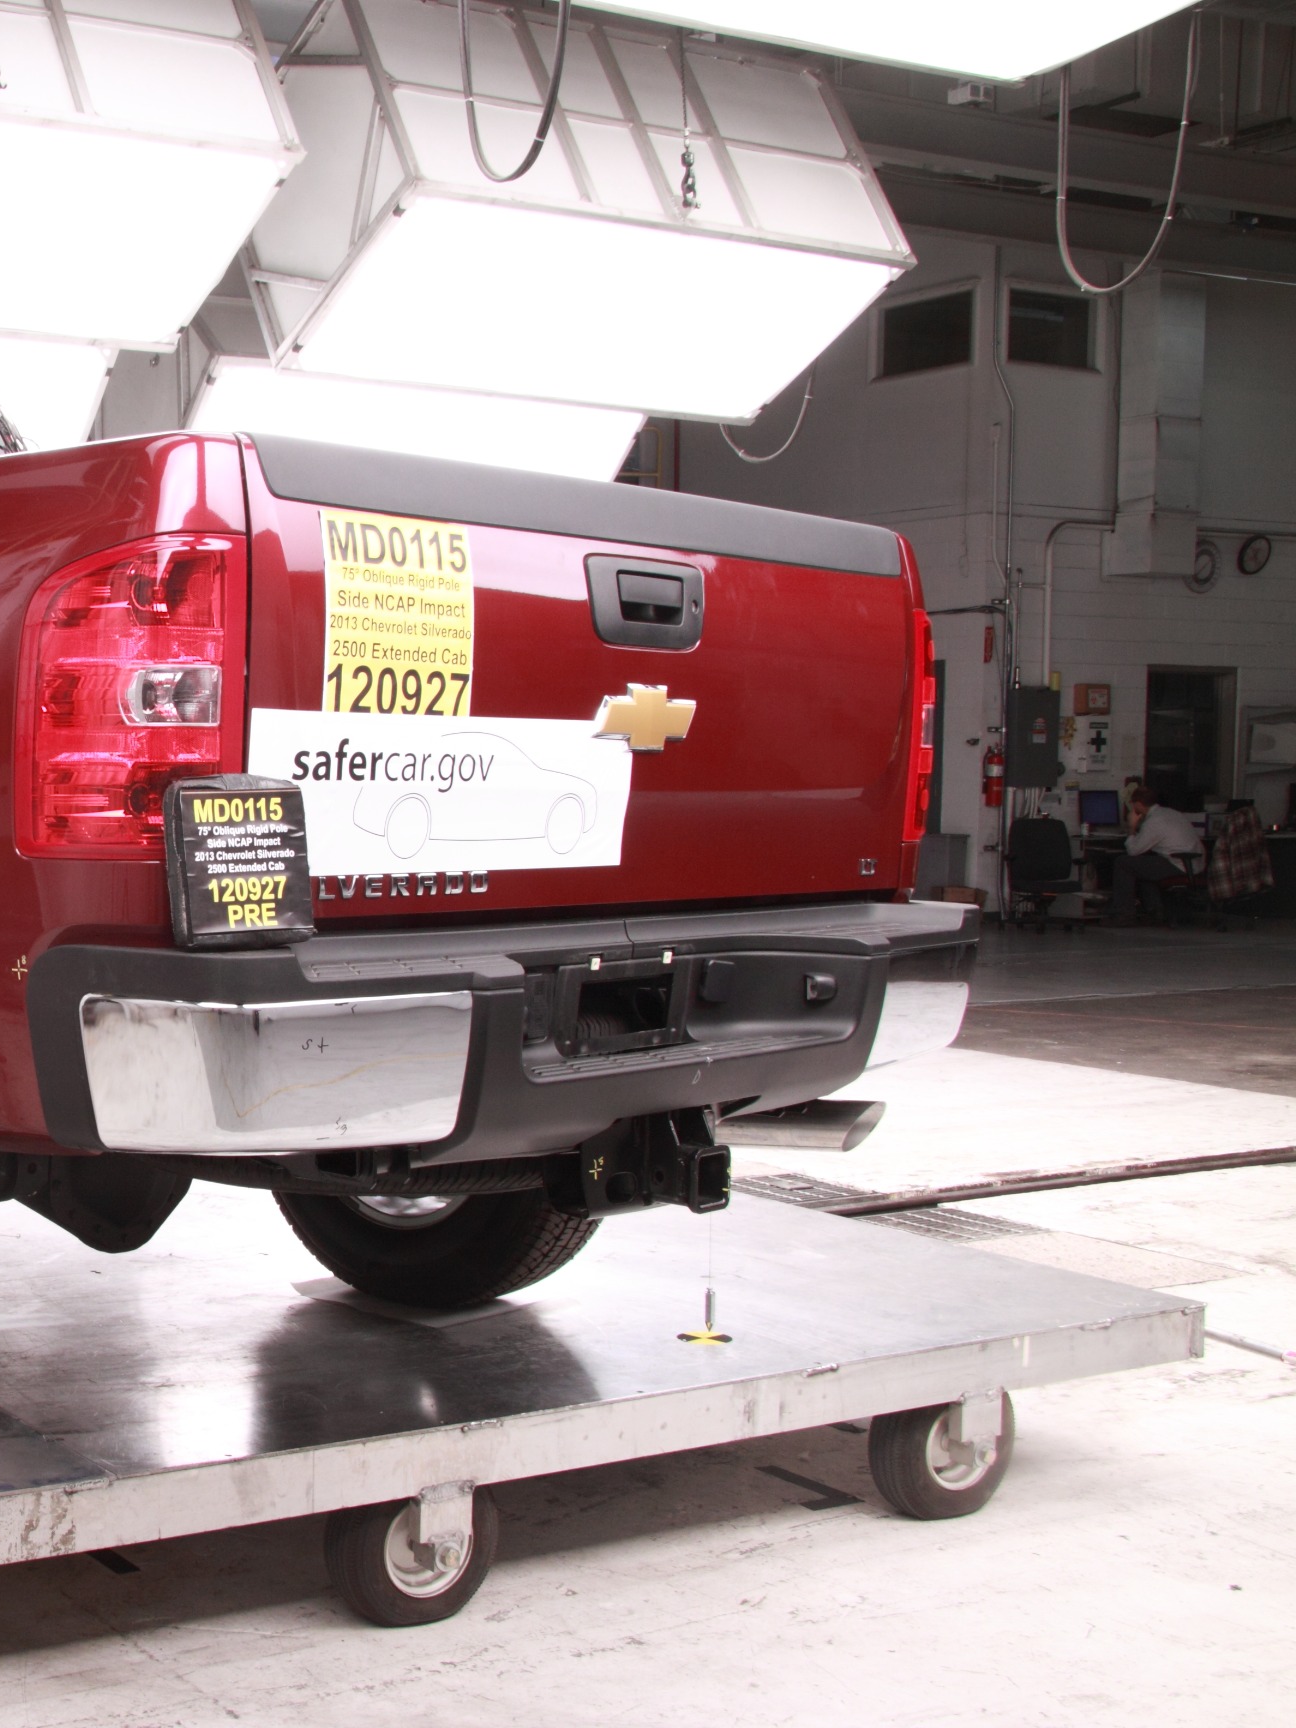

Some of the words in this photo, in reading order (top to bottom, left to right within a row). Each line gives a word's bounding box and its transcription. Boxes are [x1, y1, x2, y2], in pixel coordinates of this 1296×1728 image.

[327, 520, 466, 573] MD0115
[363, 569, 404, 587] Oblique
[408, 574, 435, 591] Rigid
[438, 577, 460, 592] Pole
[337, 589, 369, 609] Side
[375, 594, 415, 613] NCAP
[420, 598, 466, 620] Impact
[330, 614, 358, 630] 2013
[362, 617, 418, 636] Chevrolet
[421, 622, 472, 640] Silverado
[333, 639, 367, 658] 2500
[372, 642, 437, 664] Extended
[441, 648, 467, 666] Cab
[327, 663, 470, 717] 120927
[292, 738, 495, 793] safercar.gov
[193, 797, 284, 823] MD0115
[207, 838, 226, 848] Side
[228, 837, 252, 847] NCAP
[254, 836, 281, 848] Impact
[213, 825, 245, 836] Oblique
[247, 824, 269, 835] Rigid
[270, 823, 289, 833] Pole
[195, 851, 215, 862] 2013
[216, 849, 256, 861] Chevrolet
[257, 848, 295, 859] Silverado
[207, 863, 227, 874] 2500
[229, 862, 267, 873] Extended
[268, 861, 285, 871] Cab
[208, 875, 287, 903] 120927
[227, 902, 279, 929] PRE
